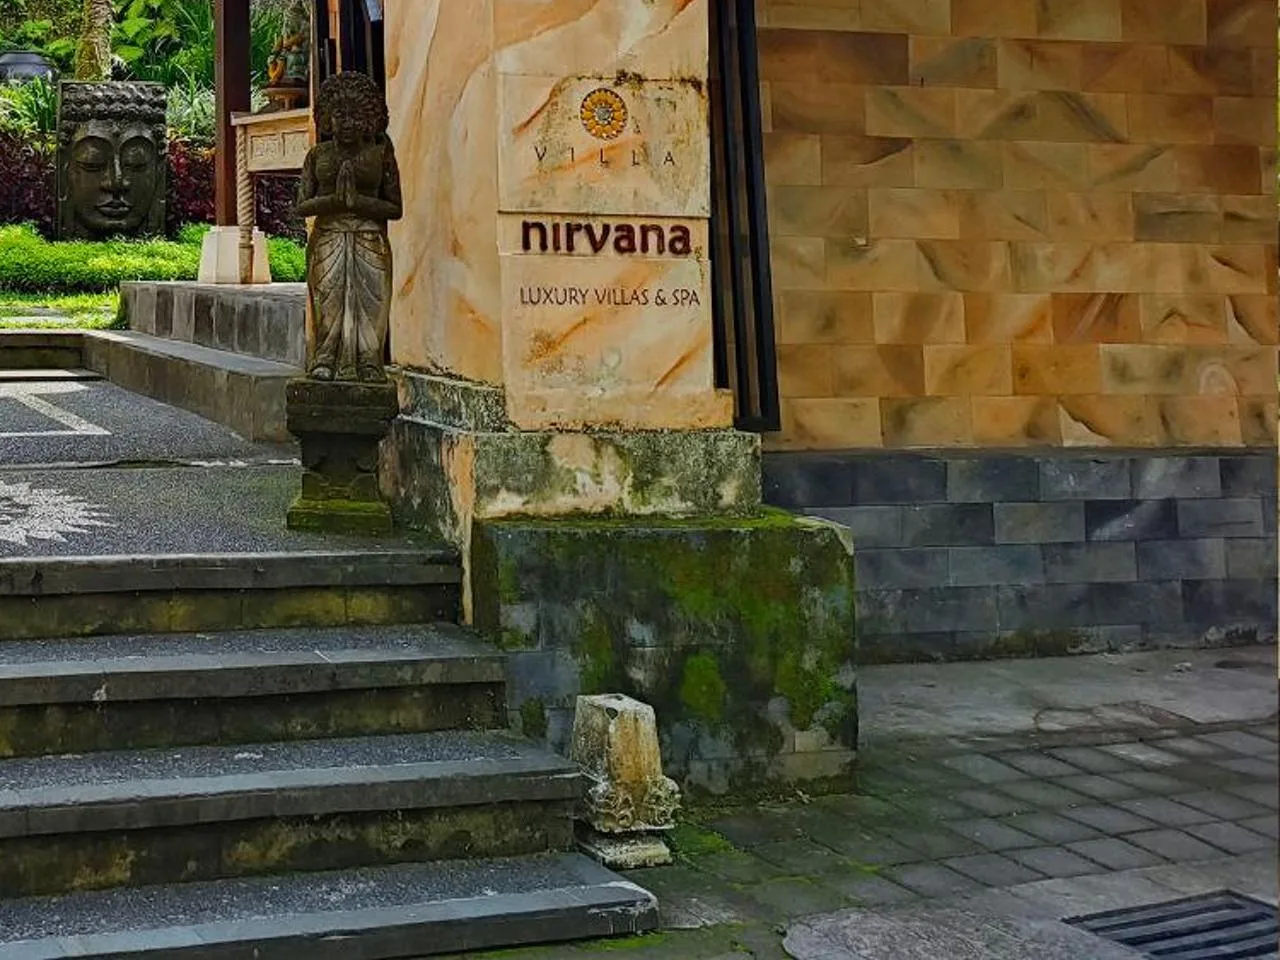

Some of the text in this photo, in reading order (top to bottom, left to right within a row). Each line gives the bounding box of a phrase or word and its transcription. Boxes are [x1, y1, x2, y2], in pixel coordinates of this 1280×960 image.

[534, 146, 675, 166] VILLA
[521, 220, 692, 255] nirvana
[520, 287, 701, 306] LUXURY VILLAS & SPA
